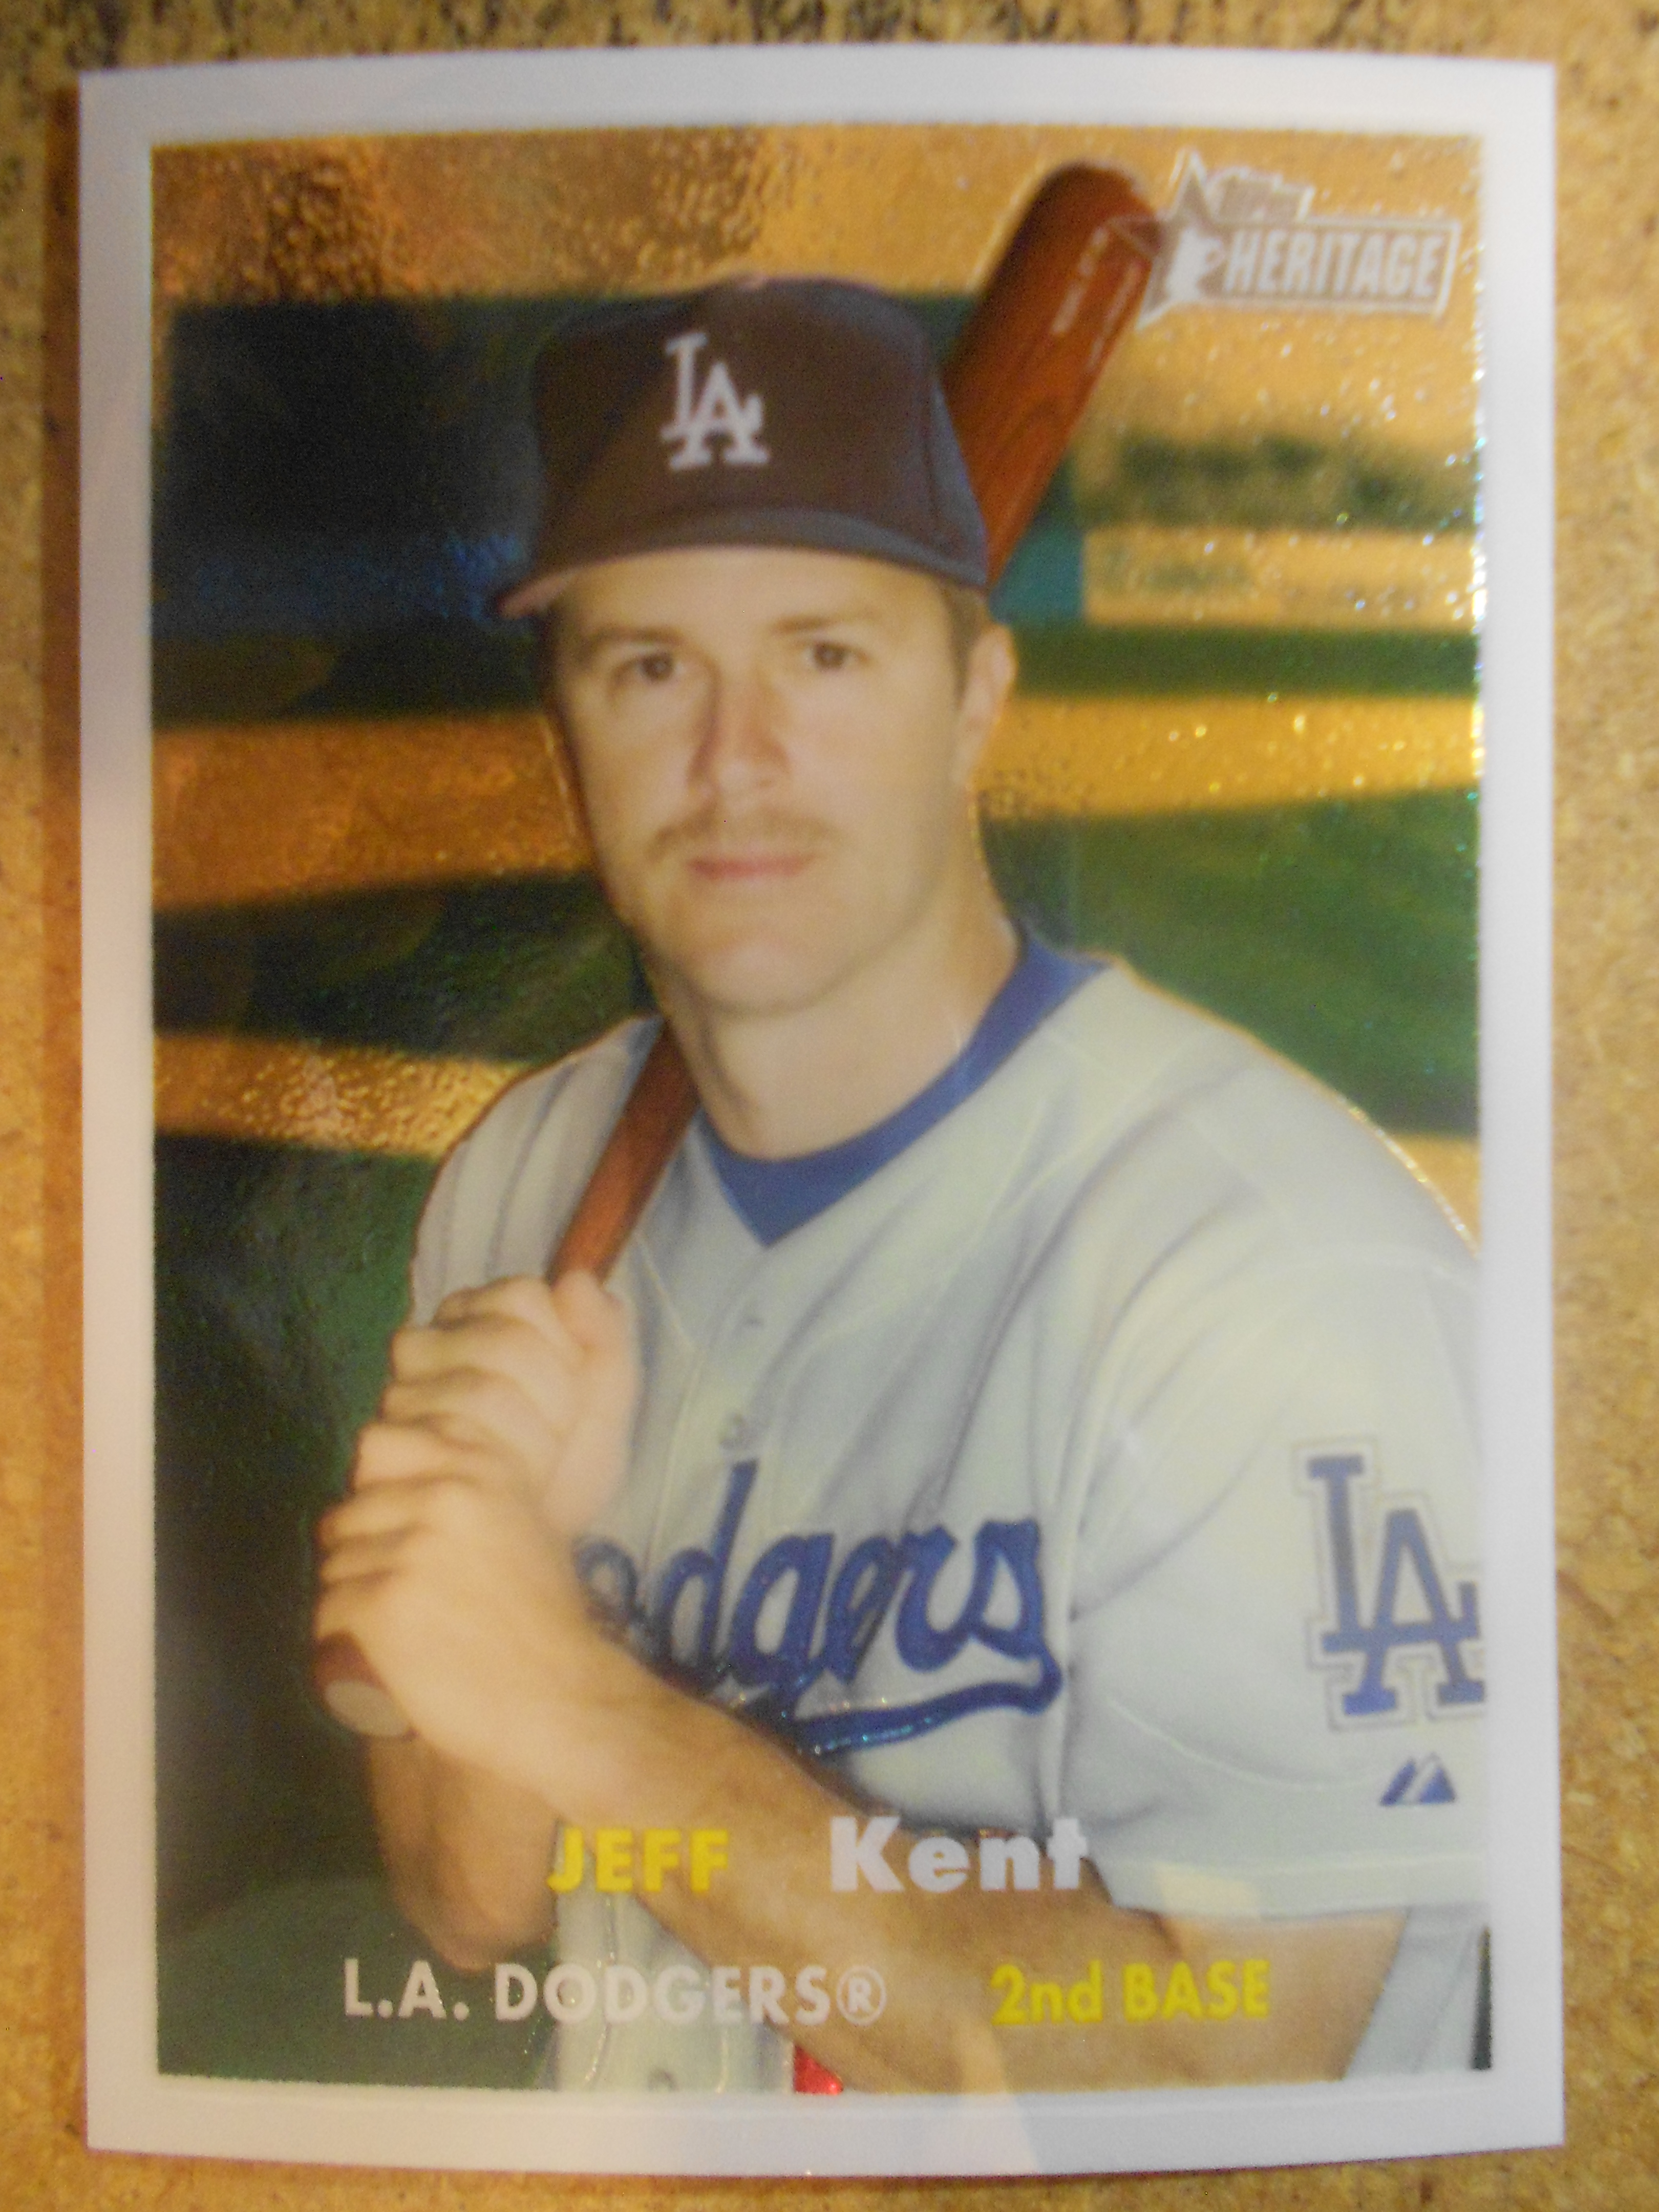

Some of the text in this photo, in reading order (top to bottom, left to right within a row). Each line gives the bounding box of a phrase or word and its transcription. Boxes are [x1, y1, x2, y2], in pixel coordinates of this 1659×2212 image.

[1223, 228, 1444, 297] HERITAGE
[661, 332, 769, 469] LA
[572, 1459, 1063, 1741] odgers
[1307, 1454, 1485, 1715] LA
[546, 1815, 1088, 1894] JEFF Kent
[344, 1957, 470, 2020] L.A.
[990, 1958, 1270, 2026] 2nd BASE
